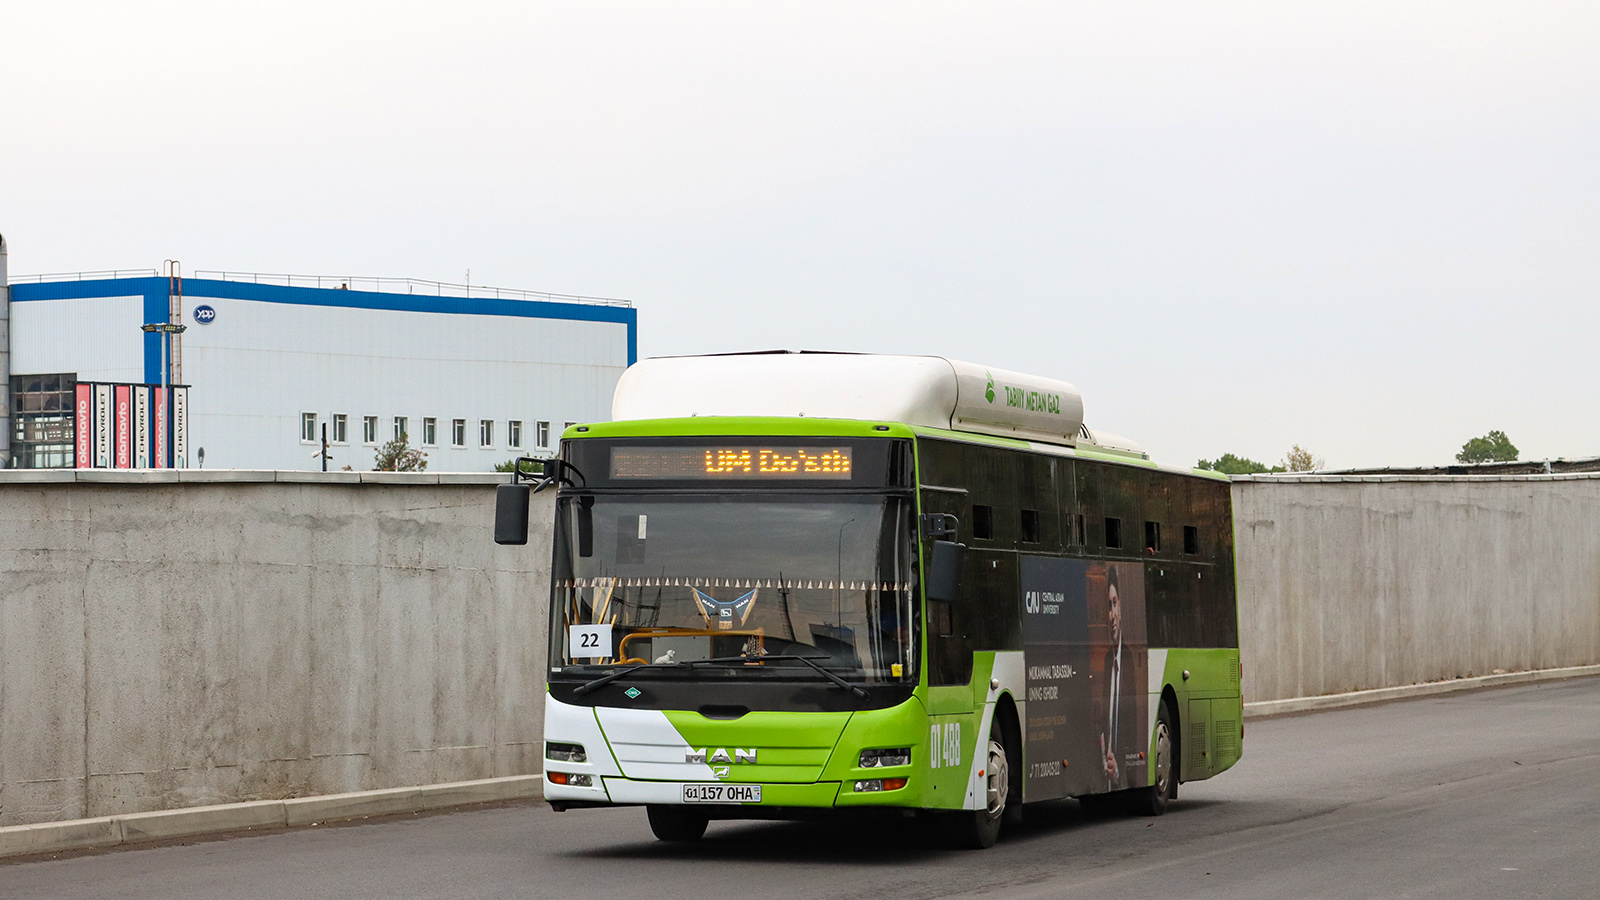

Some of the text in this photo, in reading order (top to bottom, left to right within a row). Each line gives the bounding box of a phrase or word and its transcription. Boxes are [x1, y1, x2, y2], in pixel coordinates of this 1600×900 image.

[1026, 390, 1047, 412] METAN
[1047, 392, 1060, 414] GAZ
[78, 400, 87, 464] olamavto
[118, 401, 127, 465] olamavto
[701, 598, 716, 609] MAN
[735, 598, 749, 609] MAN
[580, 633, 599, 648] 22
[930, 722, 961, 769] 01 488
[685, 748, 757, 763] MAN
[686, 787, 699, 799] 01
[700, 786, 723, 800] 157
